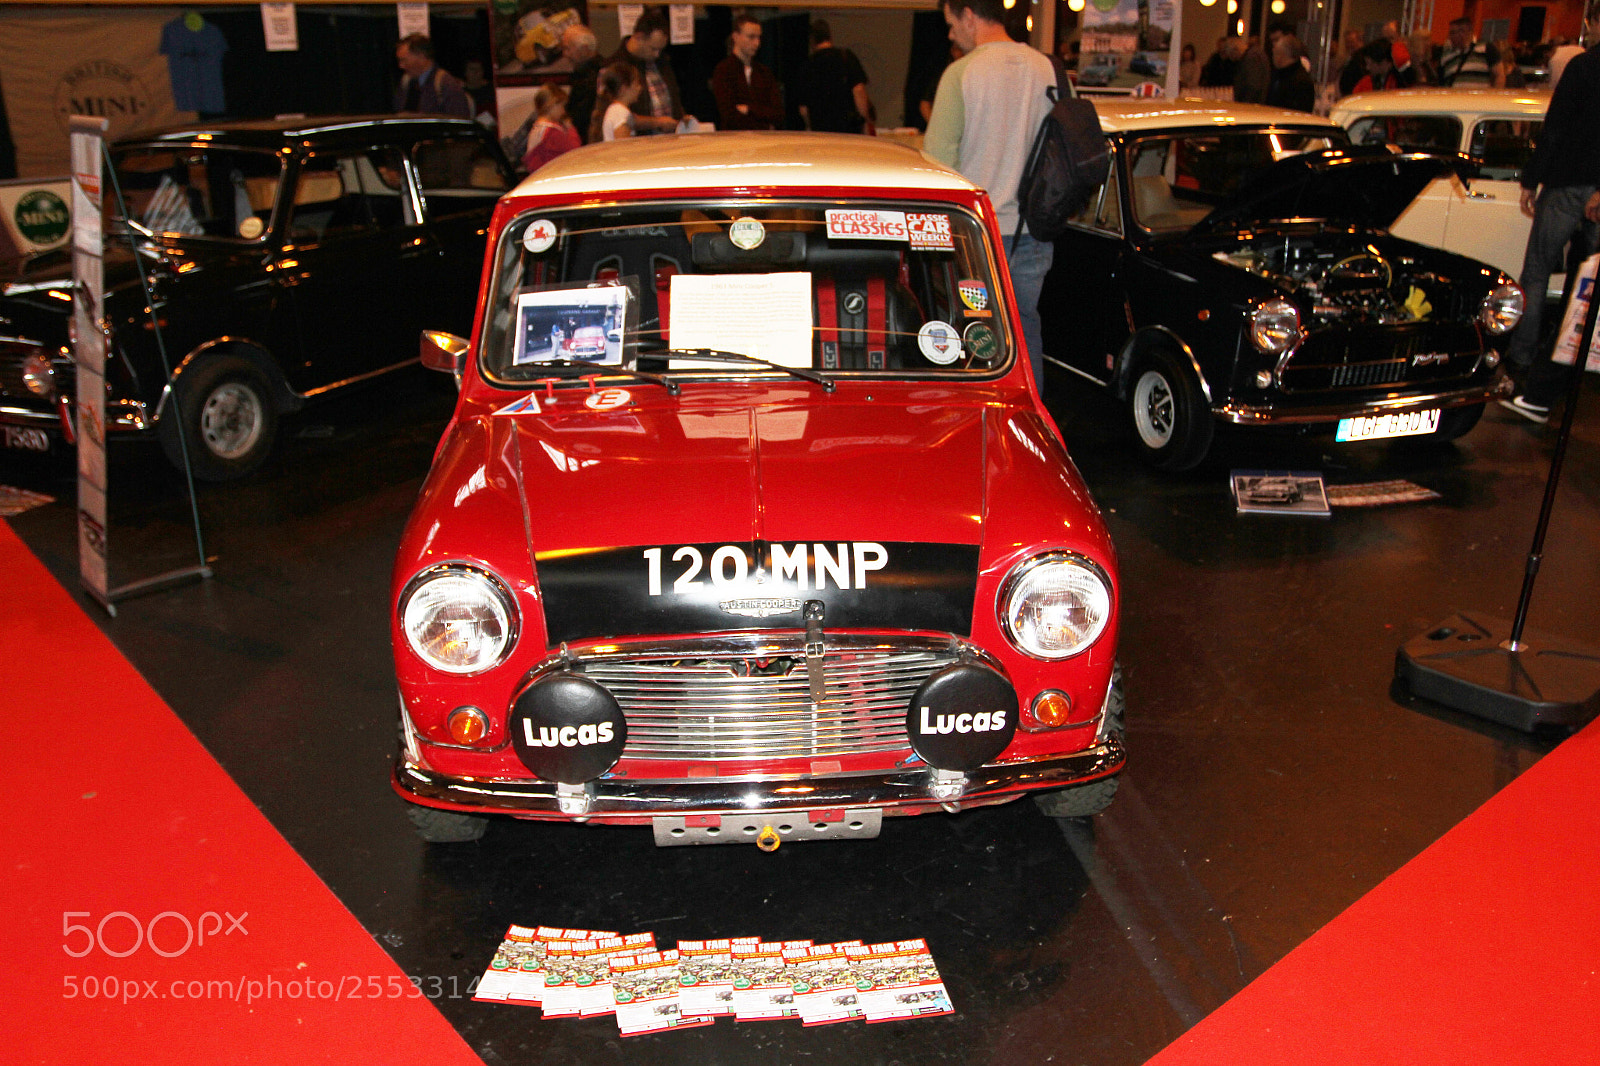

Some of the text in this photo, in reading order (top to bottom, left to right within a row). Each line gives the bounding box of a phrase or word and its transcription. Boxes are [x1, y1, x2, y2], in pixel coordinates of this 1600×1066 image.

[830, 212, 878, 222] practical
[906, 213, 949, 222] CLASSIC
[830, 220, 905, 236] CLASSICS
[908, 221, 951, 234] CAR
[909, 233, 952, 242] WEEKLY
[643, 542, 889, 596] 120 MNP
[920, 706, 1007, 735] Lucas
[523, 717, 615, 748] Lucas
[509, 925, 536, 938] MINI
[537, 926, 563, 938] MINI
[563, 929, 588, 940] FAIR
[572, 940, 597, 951] MINI
[599, 937, 623, 949] FAIR
[625, 933, 652, 945] 2016
[679, 941, 704, 951] MINI
[706, 939, 730, 949] FAIR
[731, 944, 757, 954] MINI
[758, 942, 782, 953] FAIR
[845, 939, 924, 956] MINI FAIR 2016
[781, 949, 807, 959] MINI
[808, 944, 834, 956] FAIR
[609, 956, 635, 967] MINI
[637, 952, 661, 965] FAIR
